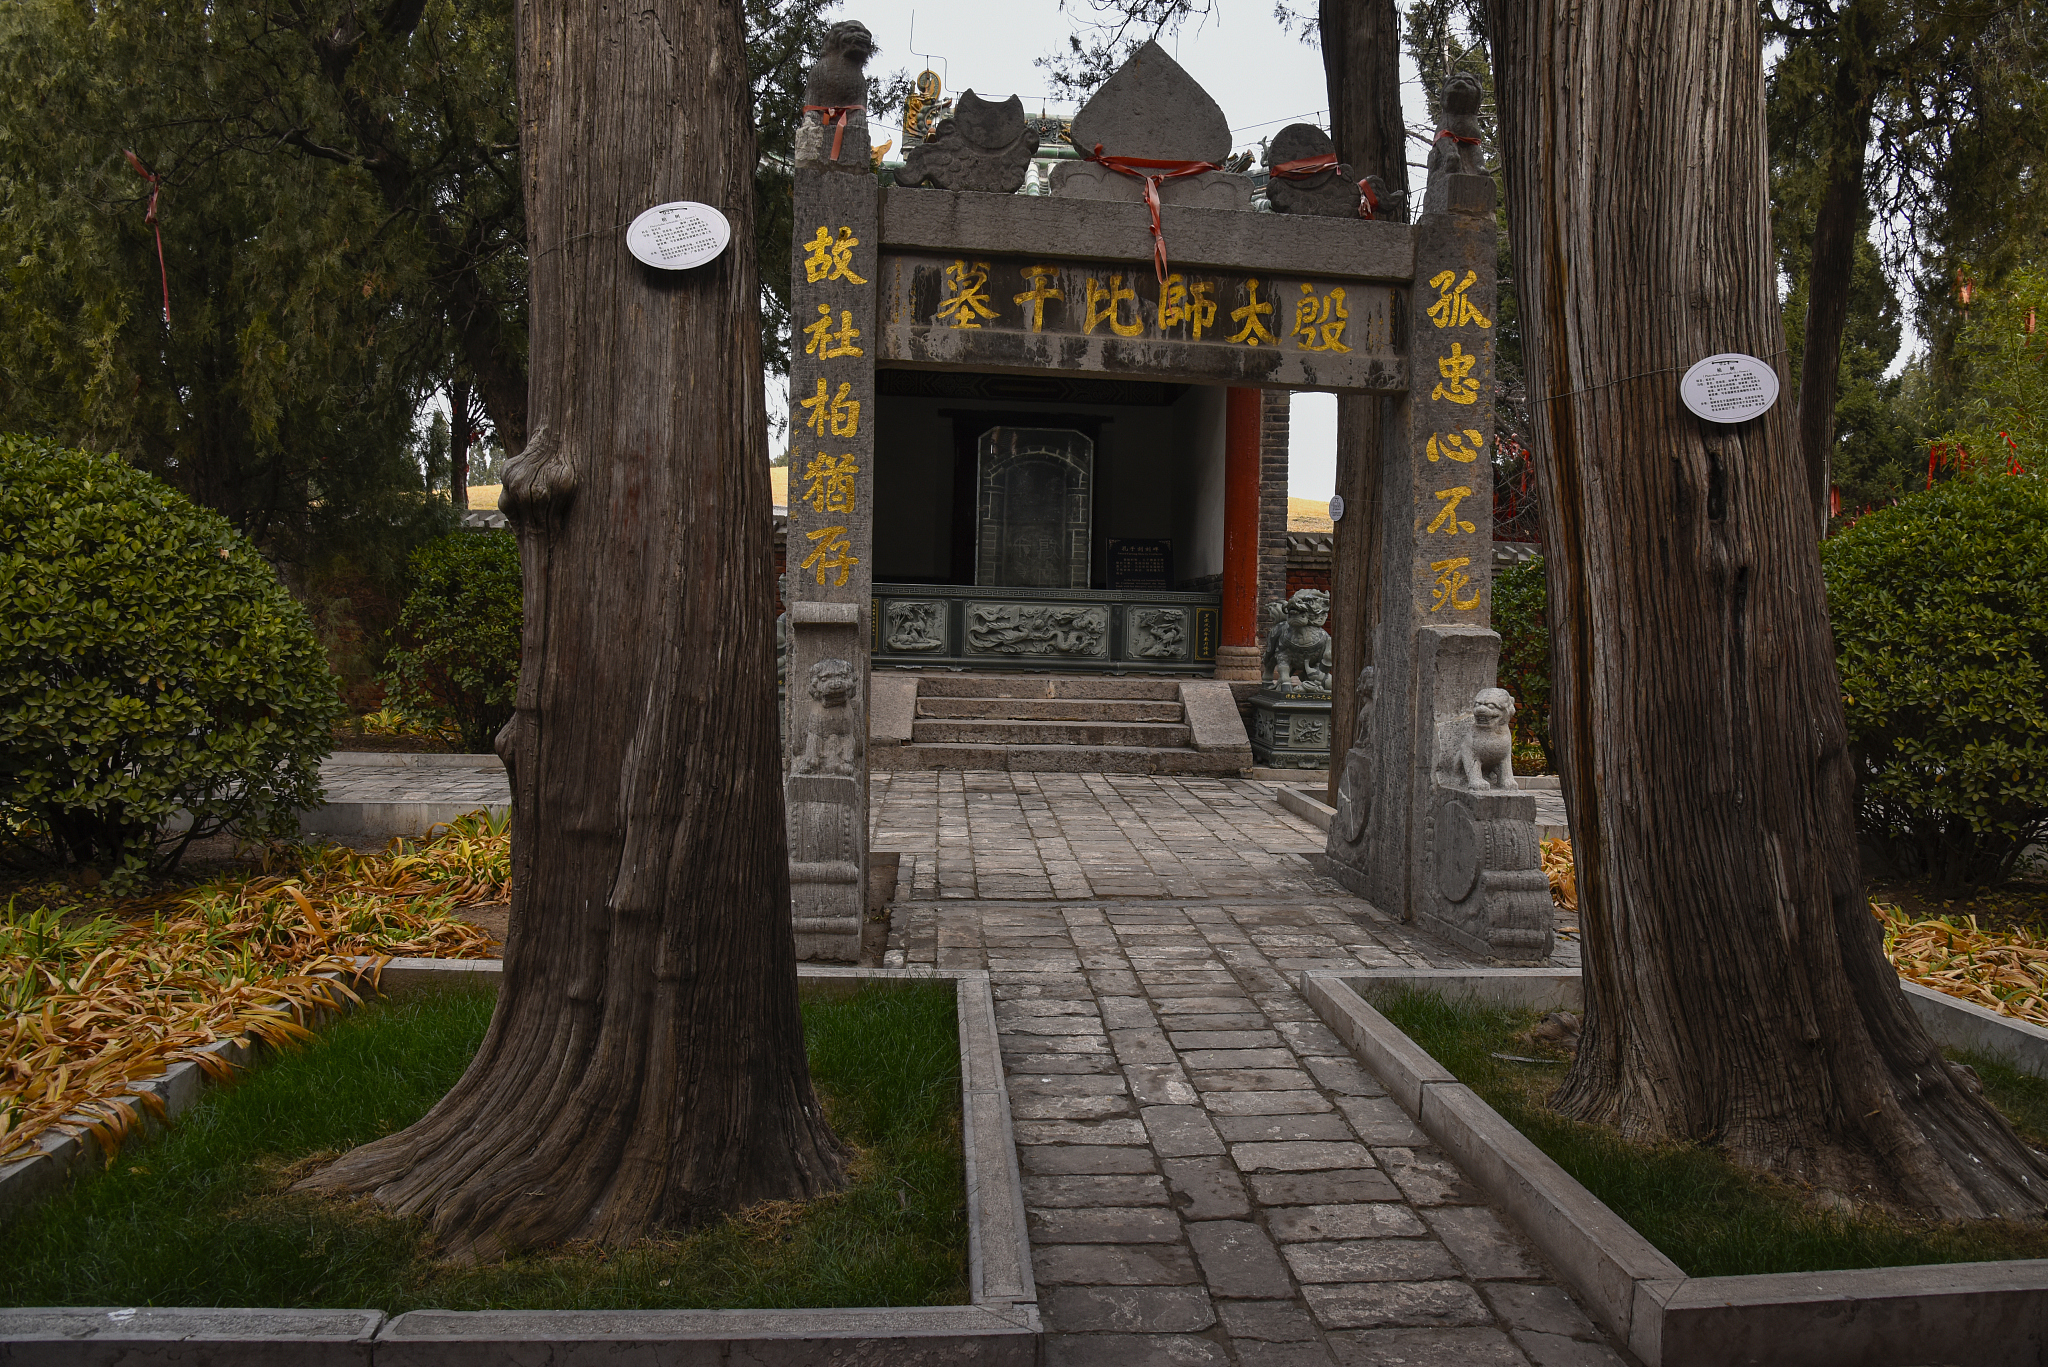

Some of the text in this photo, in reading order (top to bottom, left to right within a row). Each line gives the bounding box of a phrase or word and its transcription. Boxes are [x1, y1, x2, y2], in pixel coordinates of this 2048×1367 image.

[801, 226, 868, 587] 故社柏猶存
[1426, 269, 1492, 612] 孤忠心不死
